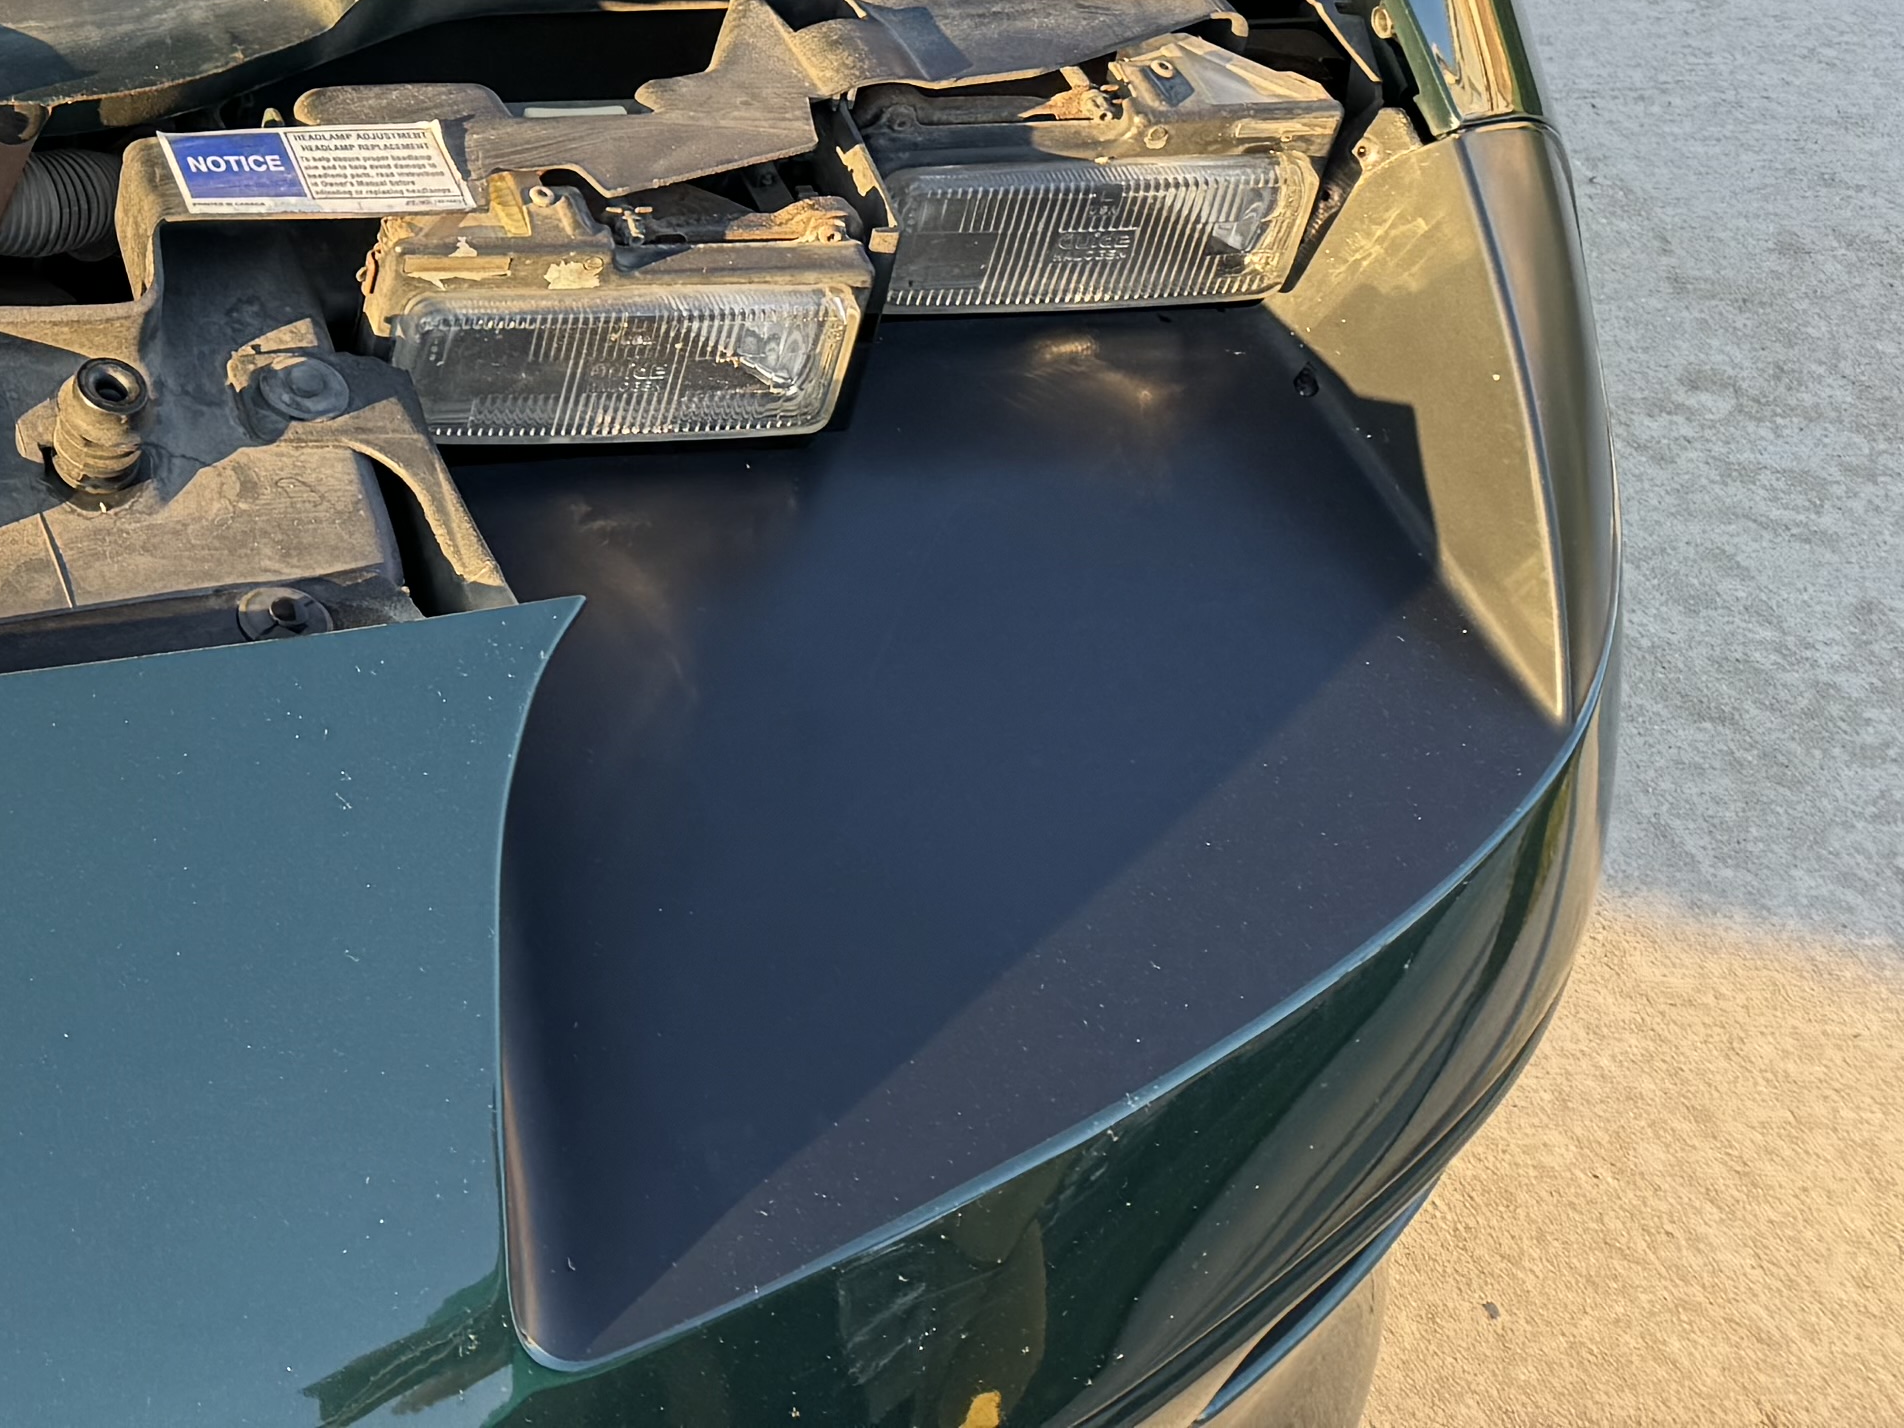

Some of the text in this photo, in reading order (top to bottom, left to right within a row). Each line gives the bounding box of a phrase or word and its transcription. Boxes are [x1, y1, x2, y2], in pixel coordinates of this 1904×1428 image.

[293, 131, 428, 142] HEADLAMP ADJUSTMENT
[301, 143, 355, 152] HEADLAMP
[186, 154, 285, 173] NOTICE
